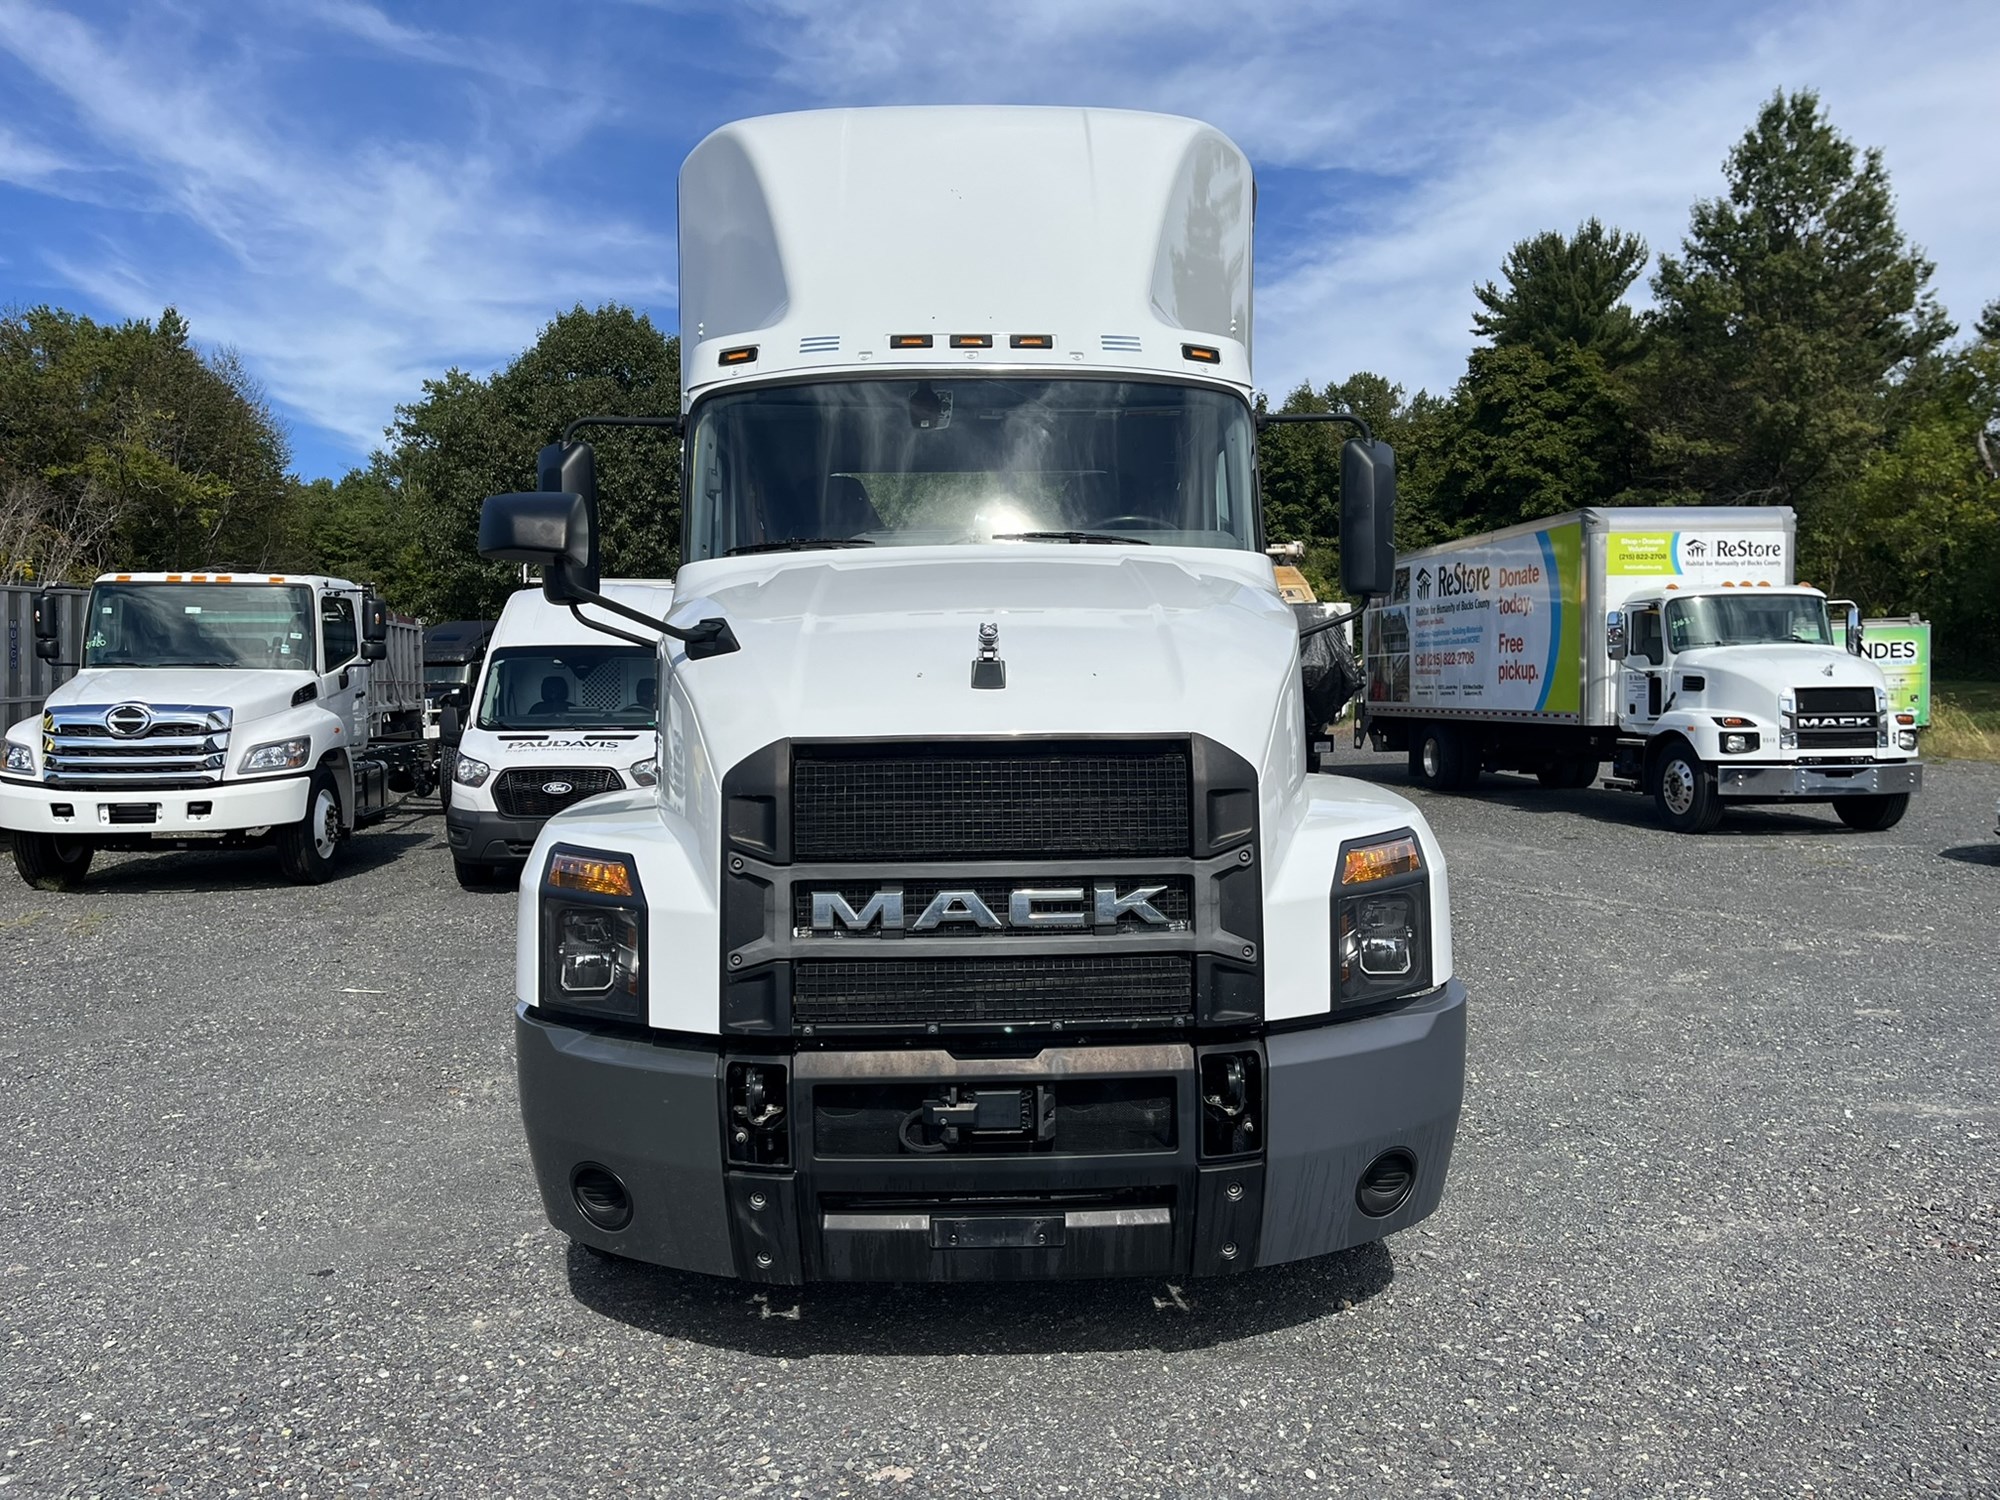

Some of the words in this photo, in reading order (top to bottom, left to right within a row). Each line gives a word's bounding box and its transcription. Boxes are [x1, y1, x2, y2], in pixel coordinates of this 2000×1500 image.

[1717, 539, 1781, 557] ReStore
[1438, 562, 1490, 598] ReStore
[1499, 563, 1540, 588] Donate
[1498, 592, 1533, 616] today.
[1498, 633, 1524, 654] Free
[1415, 653, 1427, 666] Call
[1498, 659, 1539, 685] pickup.
[1798, 717, 1871, 727] MACK
[547, 783, 567, 793] Ford
[811, 884, 1172, 930] MACK
